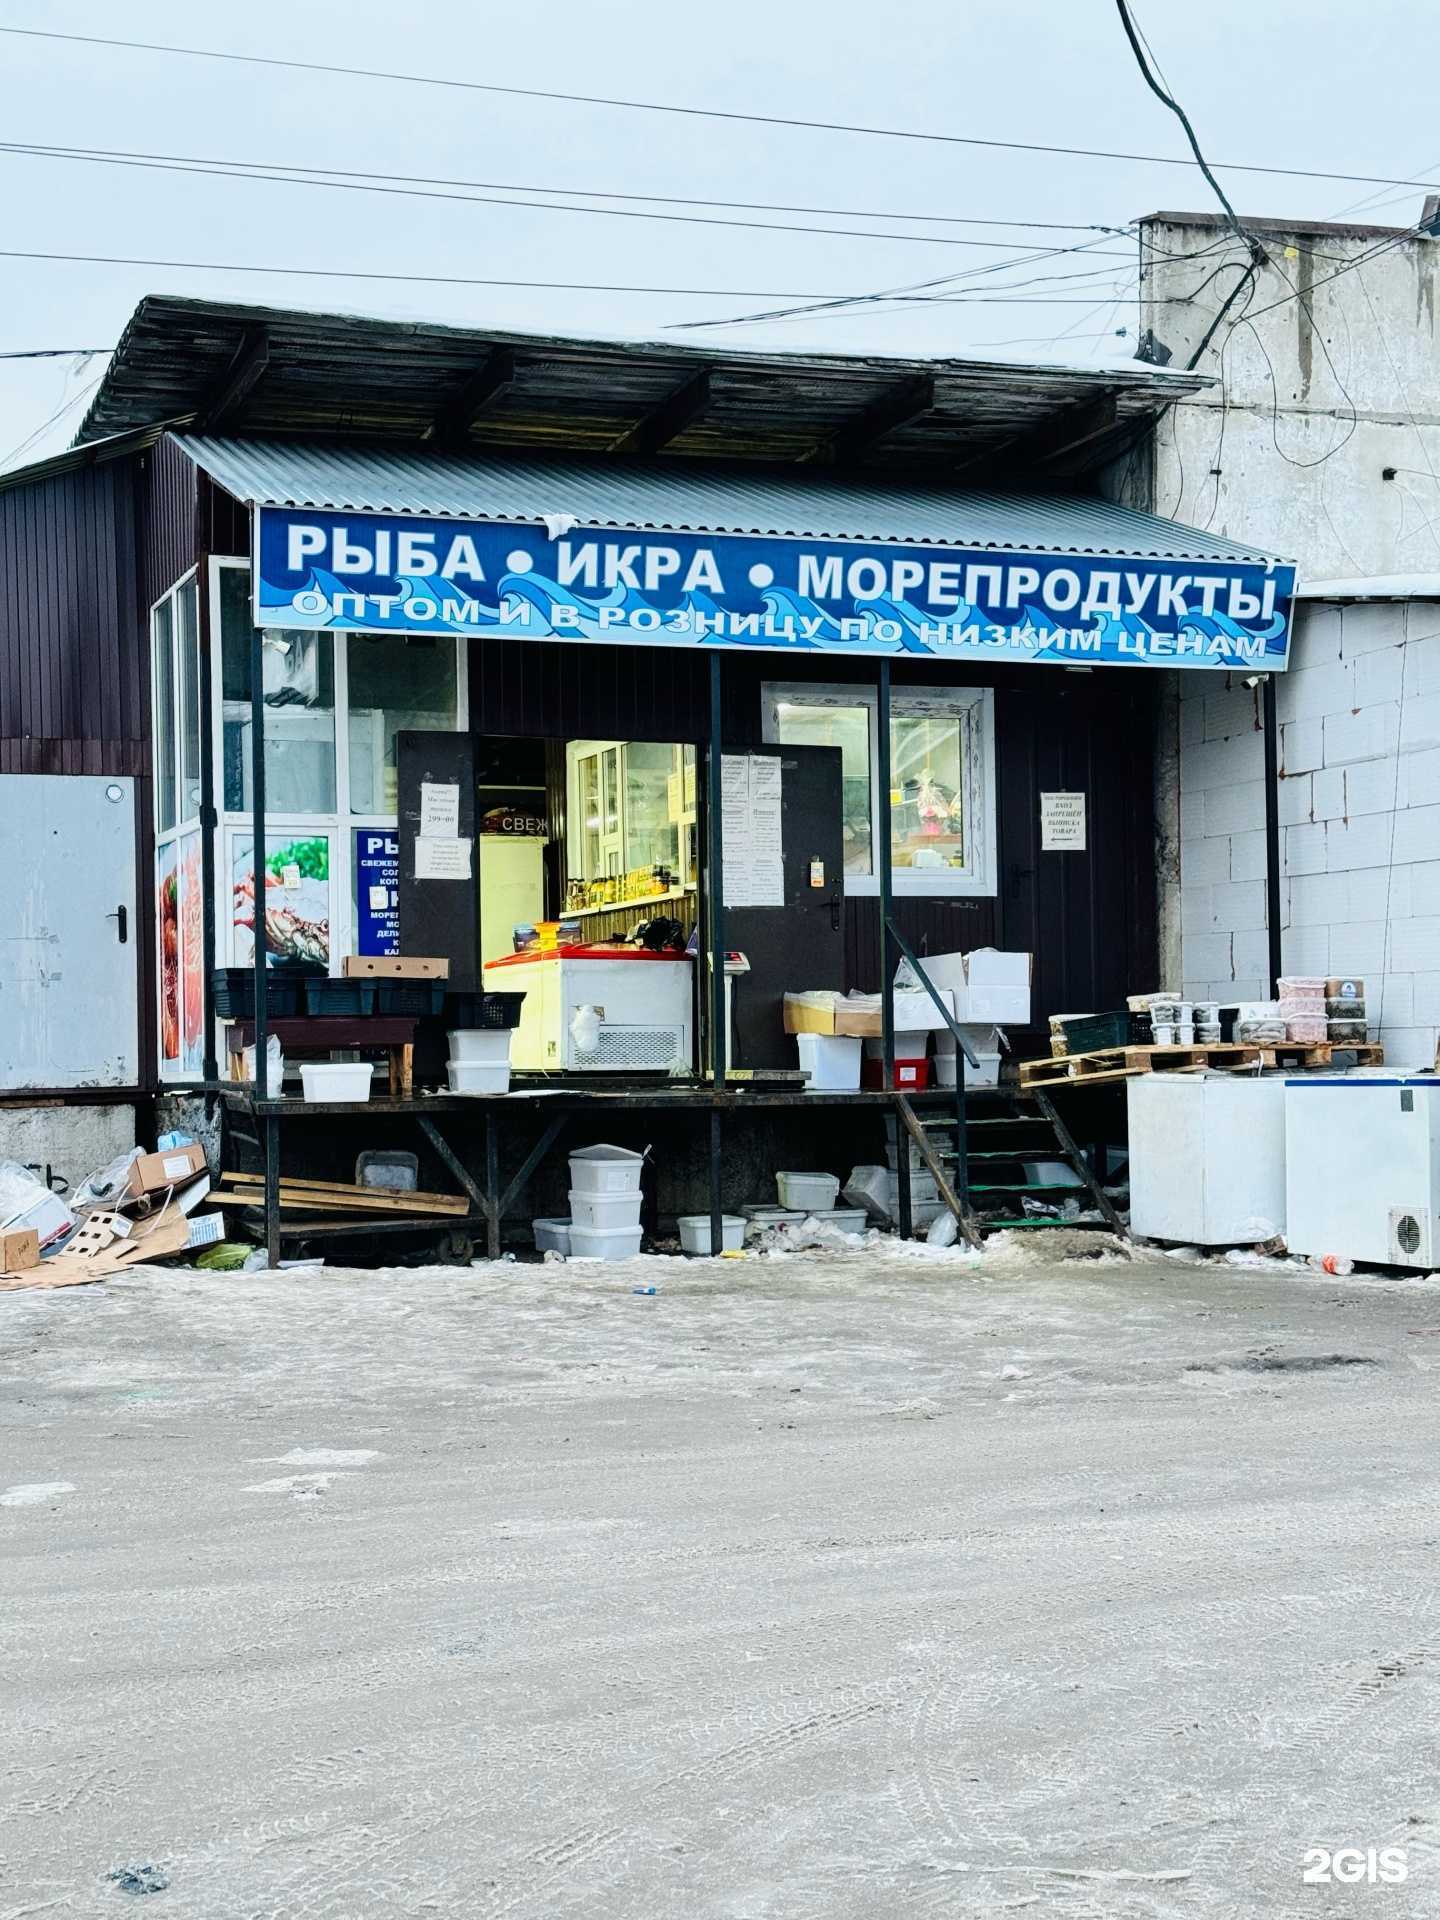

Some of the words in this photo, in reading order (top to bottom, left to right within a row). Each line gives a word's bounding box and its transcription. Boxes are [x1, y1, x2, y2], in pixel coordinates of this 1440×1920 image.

[288, 524, 486, 582] РЫБА
[557, 541, 725, 594] ИКРА
[798, 554, 1276, 620] МОРЕПРОДУКТЫ
[292, 590, 481, 624] ОПТОМ
[499, 601, 532, 626] И
[550, 604, 581, 628] В
[599, 606, 825, 642] РОЗНИЦУ
[840, 617, 903, 642] ПО
[919, 622, 1102, 651] НИЗКИМ
[1118, 631, 1267, 658] ЦЕНАМ
[502, 817, 548, 831] СВЕЖ
